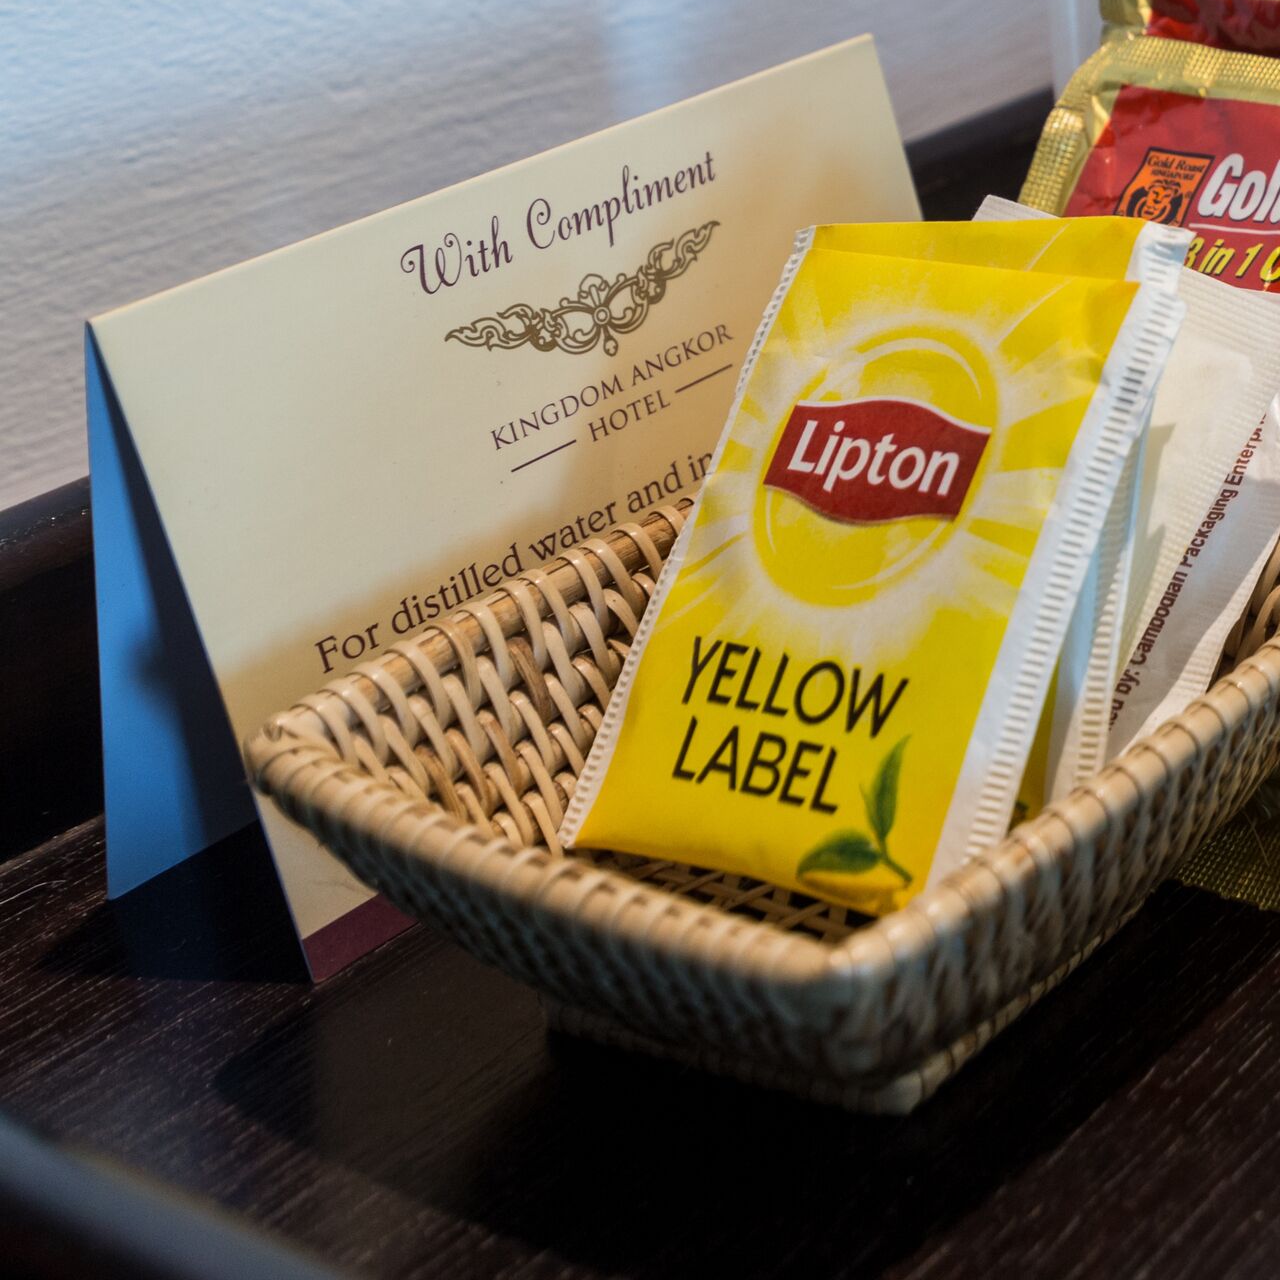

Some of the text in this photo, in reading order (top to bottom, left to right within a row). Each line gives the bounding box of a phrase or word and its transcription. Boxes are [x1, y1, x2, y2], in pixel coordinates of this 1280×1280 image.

[400, 151, 716, 294] With Compliment
[1183, 237, 1205, 268] 3
[1201, 239, 1236, 275] in
[1235, 243, 1265, 277] 1
[489, 323, 735, 451] KINGDOM ANGKOR
[587, 389, 672, 443] HOTEL
[786, 419, 961, 498] Lipton
[313, 627, 381, 673] For
[390, 543, 524, 637] distilled
[529, 500, 617, 562] water
[627, 460, 684, 513] and
[681, 635, 909, 739] YELLOW
[671, 716, 838, 815] LABEL
